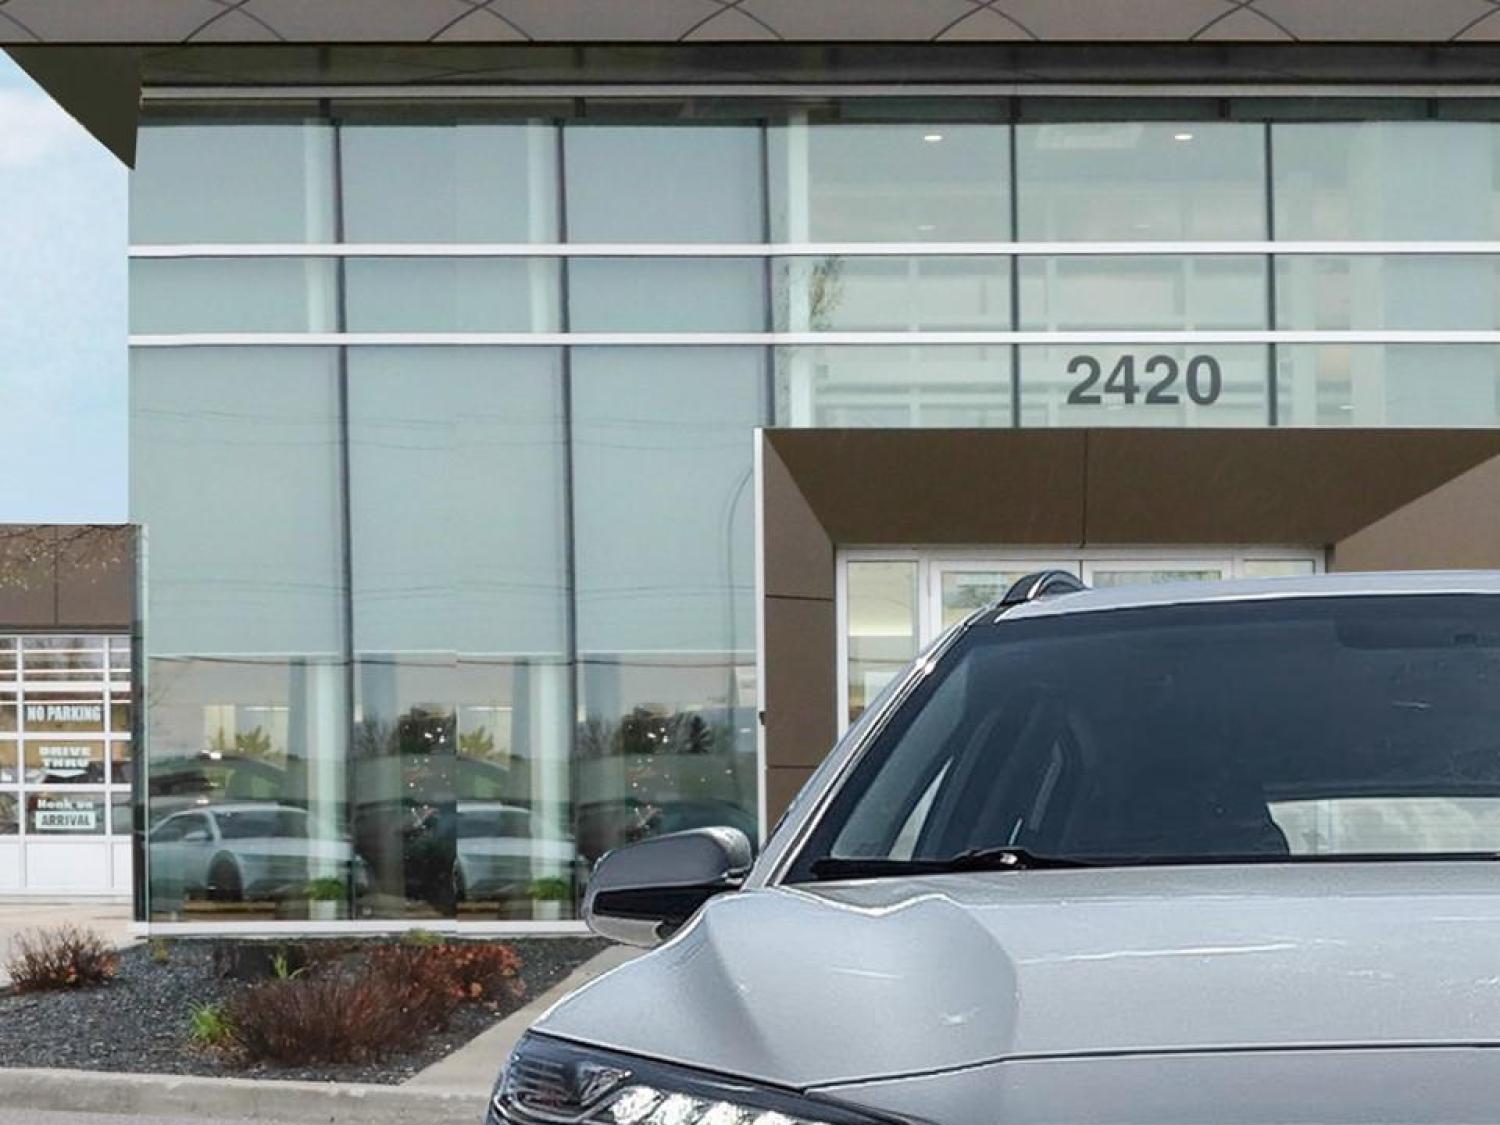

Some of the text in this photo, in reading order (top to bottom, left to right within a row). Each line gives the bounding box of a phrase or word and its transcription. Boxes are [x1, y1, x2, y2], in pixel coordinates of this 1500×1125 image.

[1066, 355, 1222, 406] 2420
[27, 706, 101, 721] NO PARKING
[41, 814, 91, 826] ARRIVAL
